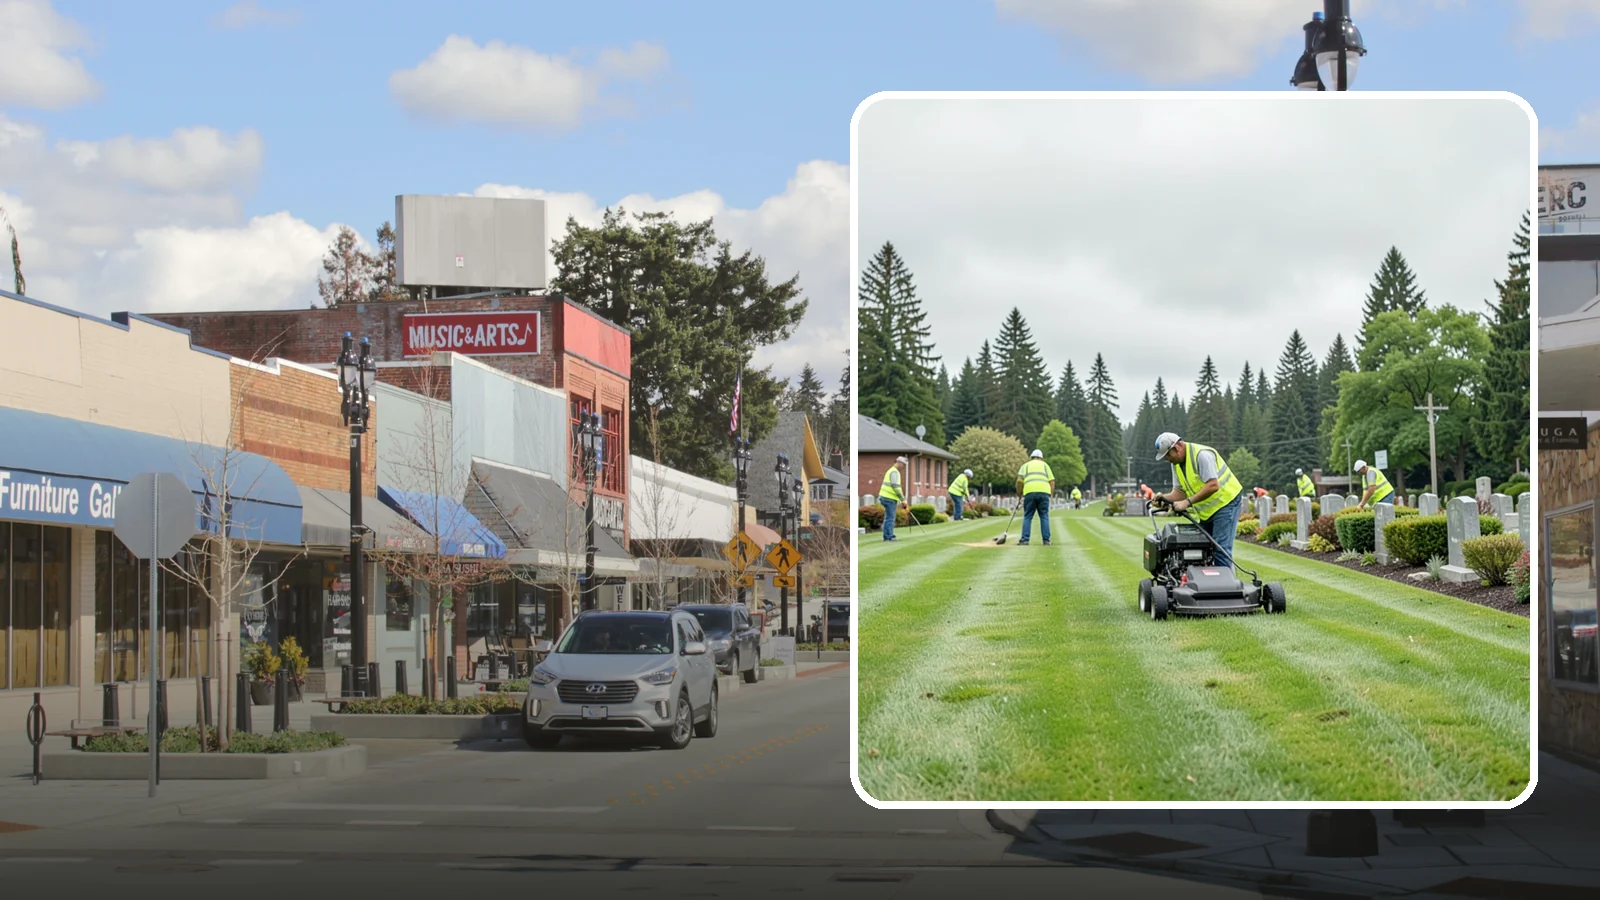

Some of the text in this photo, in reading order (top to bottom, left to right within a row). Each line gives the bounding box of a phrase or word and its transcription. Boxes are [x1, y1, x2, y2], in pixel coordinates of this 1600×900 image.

[409, 323, 519, 348] MUSIC&ARTS
[0, 471, 121, 519] Furniture Gal
